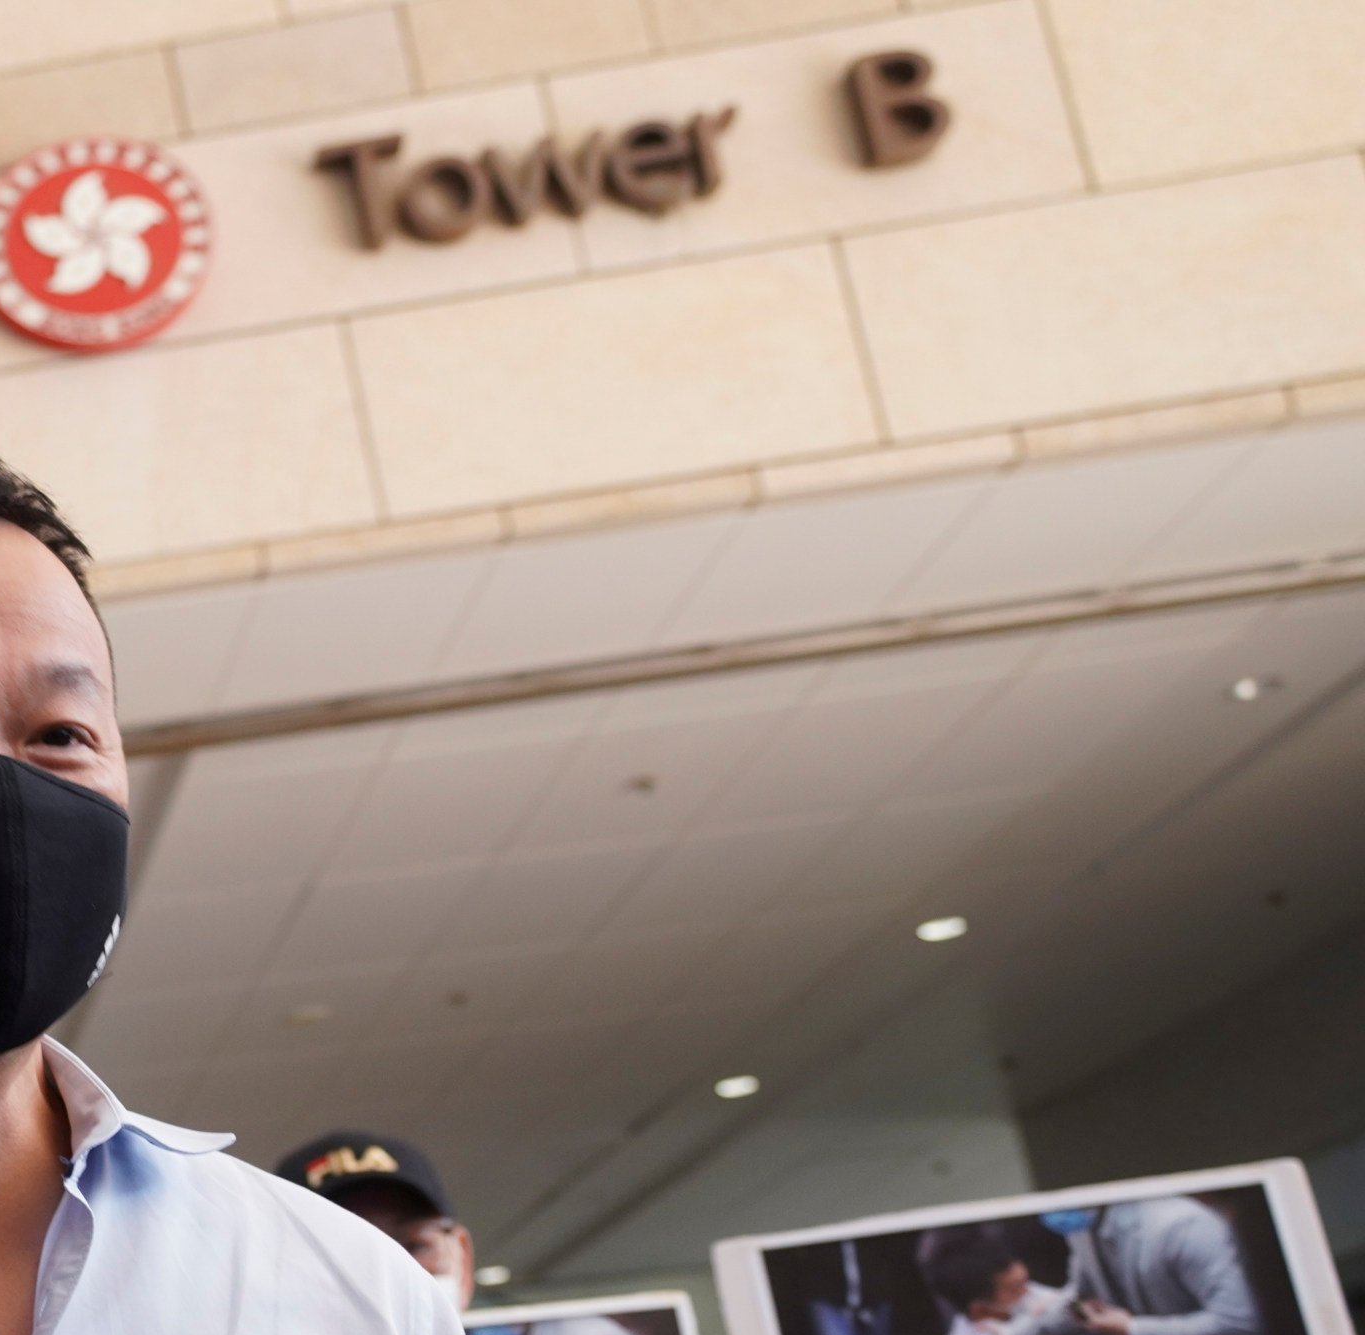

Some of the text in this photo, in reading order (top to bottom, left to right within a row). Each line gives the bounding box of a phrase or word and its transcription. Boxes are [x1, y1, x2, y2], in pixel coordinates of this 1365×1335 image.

[311, 49, 951, 252] Tower B
[305, 1145, 399, 1188] FILA
